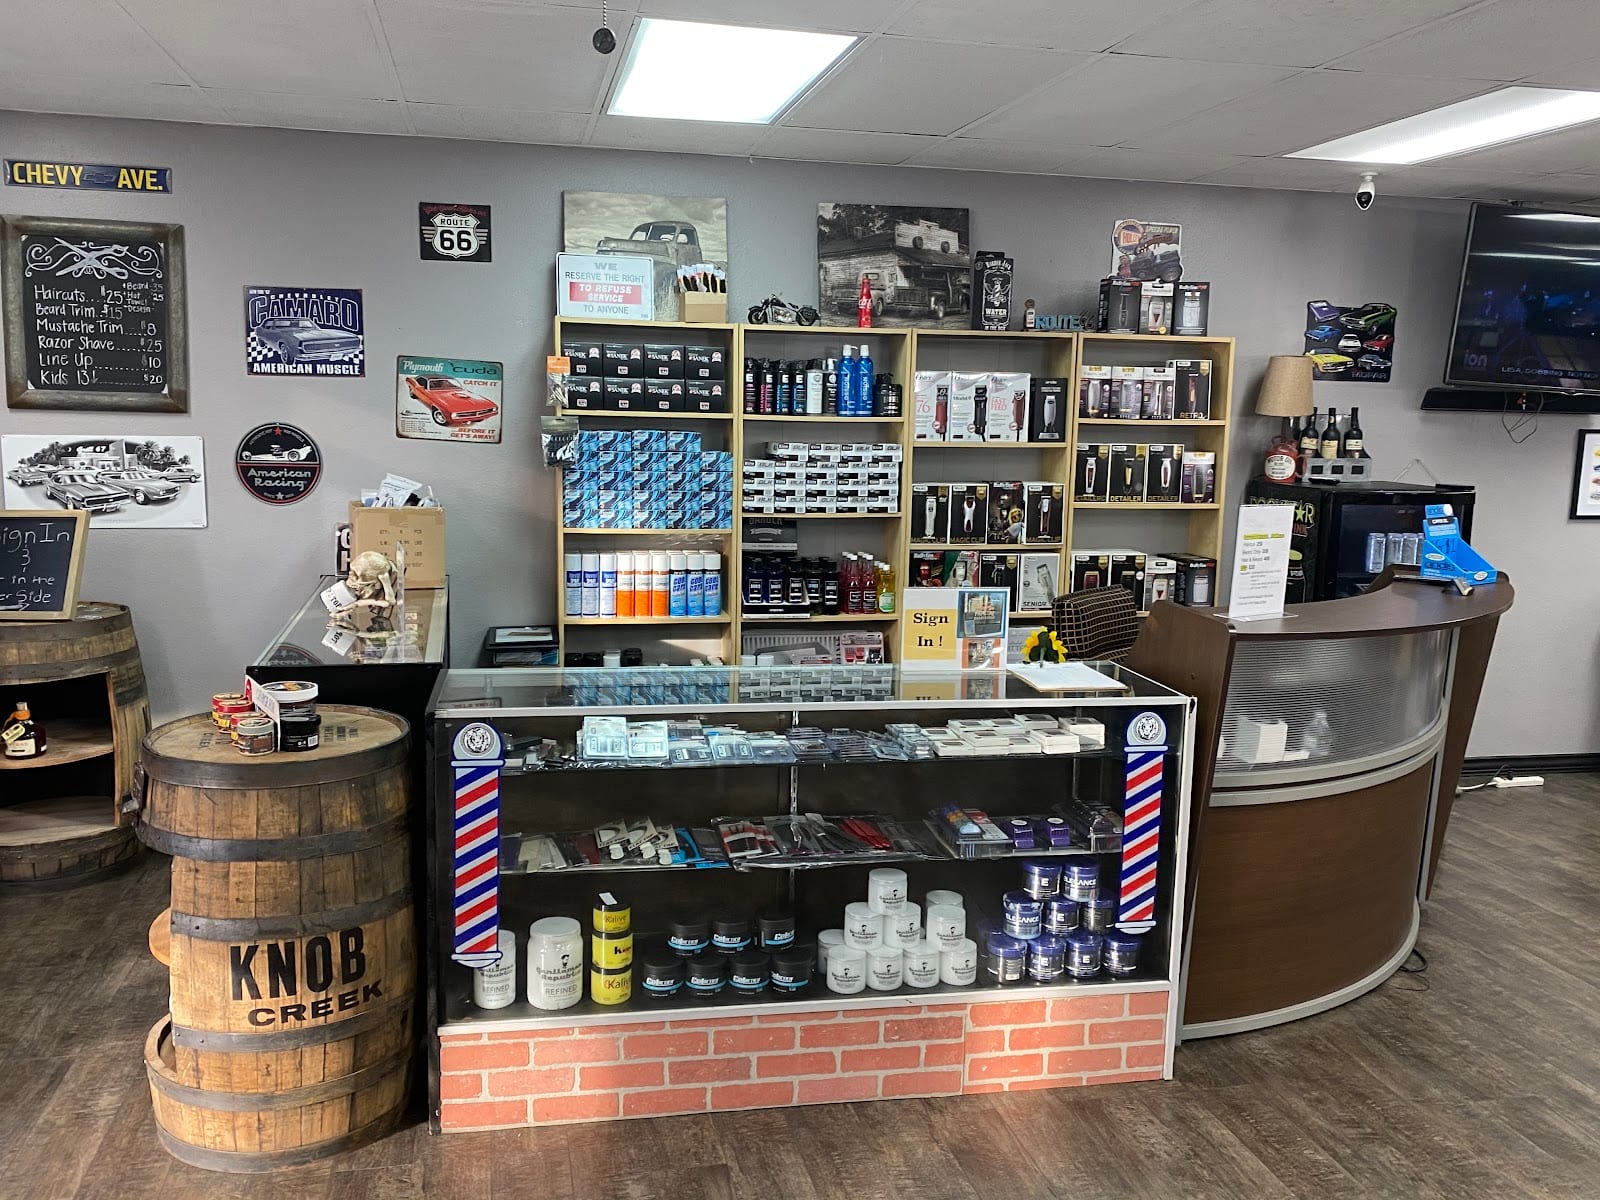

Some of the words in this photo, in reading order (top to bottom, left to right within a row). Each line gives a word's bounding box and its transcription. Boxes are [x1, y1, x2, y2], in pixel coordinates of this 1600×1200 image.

[12, 162, 84, 186] CHEVY
[116, 168, 164, 190] AVE.
[440, 218, 470, 226] ROUTE
[440, 229, 472, 251] 66
[594, 262, 617, 271] WE
[565, 271, 602, 281] RESERVE
[604, 273, 620, 282] THE
[621, 275, 645, 284] RIGHT
[34, 284, 86, 302] Haircuts
[579, 285, 592, 293] TO
[596, 286, 632, 294] REFUSE
[587, 293, 624, 303] SERVICE
[35, 302, 66, 316] Beard
[68, 303, 95, 318] Trim
[249, 296, 359, 331] CAMARO
[584, 304, 596, 313] TO
[597, 305, 629, 315] ANYONE
[985, 308, 1007, 316] WATER
[36, 318, 95, 334] Mustache
[96, 320, 123, 335] Trim
[1035, 314, 1081, 329] ROUTE
[38, 335, 74, 350] Razor
[78, 336, 115, 351] Shave
[39, 352, 69, 367] Line
[74, 352, 94, 370] Up
[403, 360, 444, 373] Plymouth
[253, 363, 313, 374] AMERICAN
[316, 364, 360, 375] MUSCLE
[40, 370, 69, 386] Kids
[916, 400, 930, 413] 76
[247, 467, 312, 478] American
[254, 478, 305, 491] Racing
[1110, 495, 1143, 503] DETAILER
[0, 527, 37, 553] ign
[39, 522, 70, 543] In
[15, 589, 52, 603] Side
[913, 612, 949, 627] Sign
[917, 636, 934, 647] In
[604, 913, 627, 924] Kalive
[230, 926, 366, 1001] KNOB
[545, 984, 578, 995] REFINED
[607, 977, 630, 989] Kali
[247, 979, 383, 1027] CREEK
